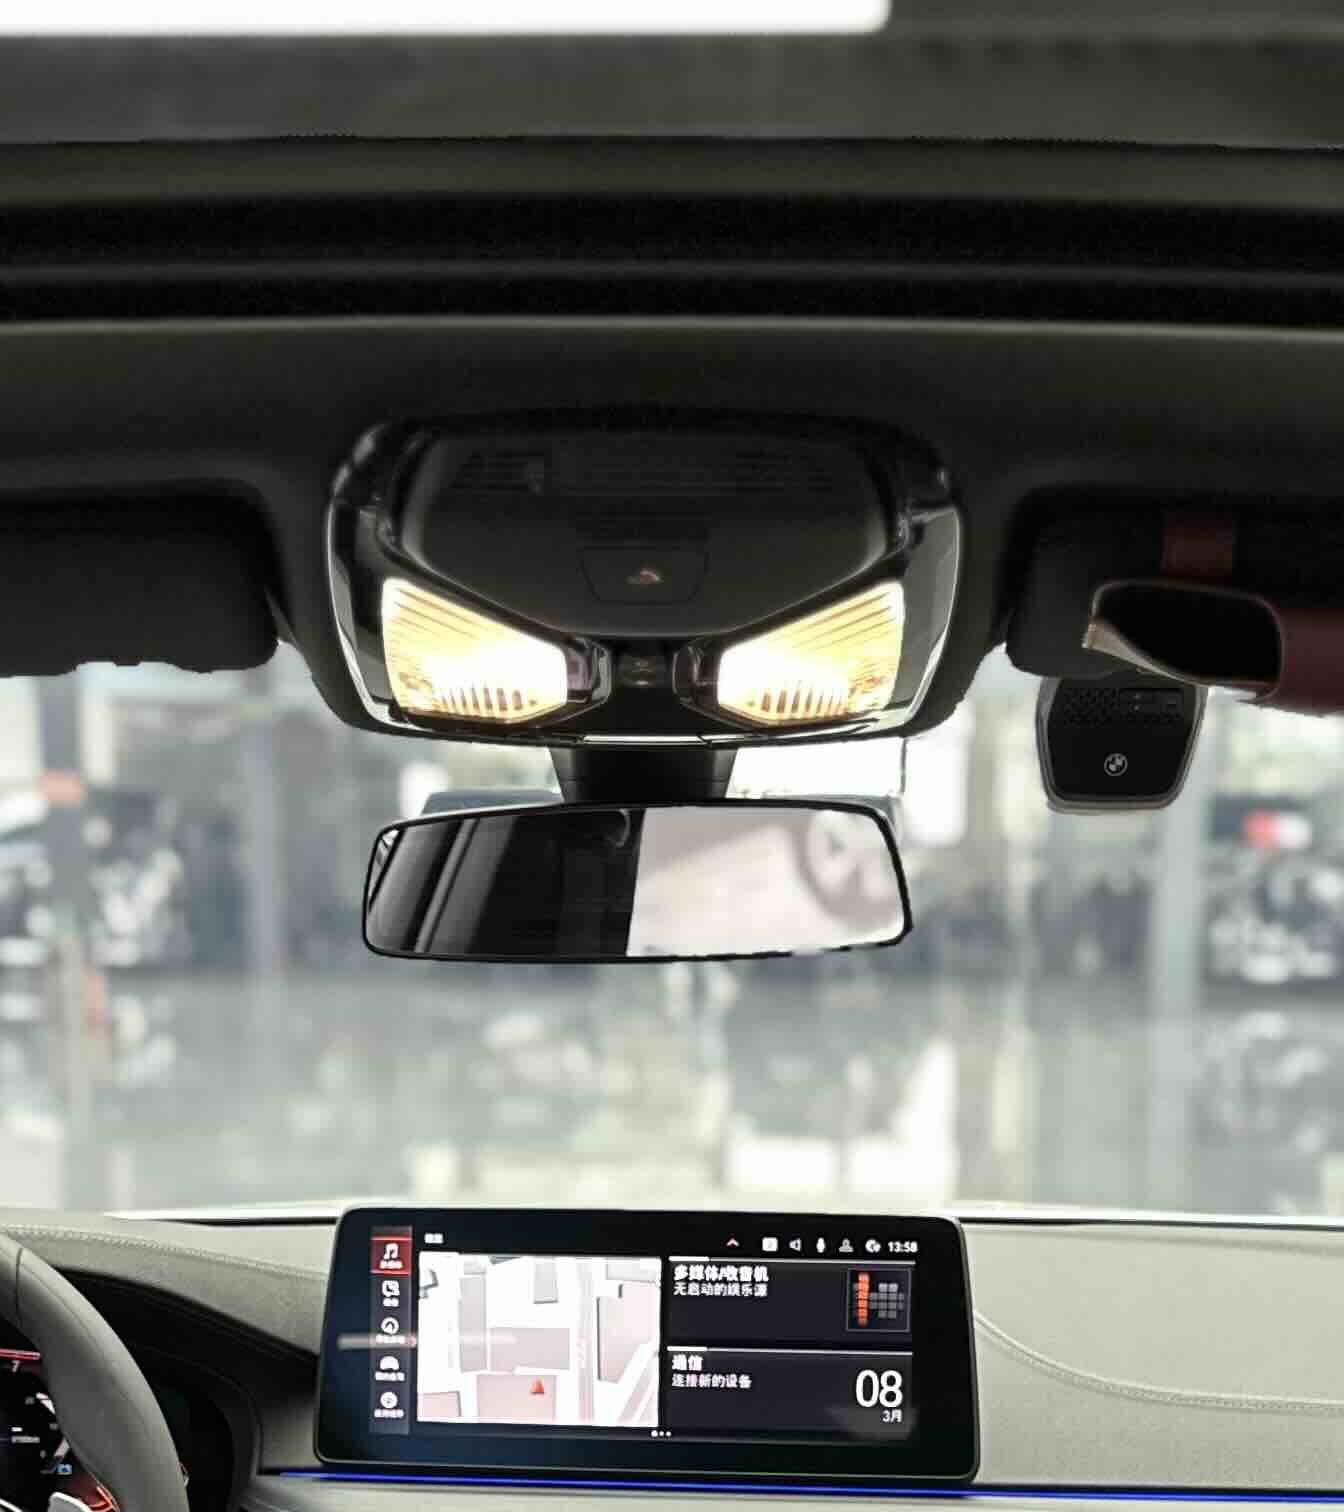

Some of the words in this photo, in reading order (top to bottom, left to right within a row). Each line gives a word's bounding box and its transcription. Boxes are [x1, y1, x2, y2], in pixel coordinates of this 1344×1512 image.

[671, 1355, 703, 1371] 通信
[856, 1369, 904, 1408] 08
[882, 1410, 903, 1423] 3月
